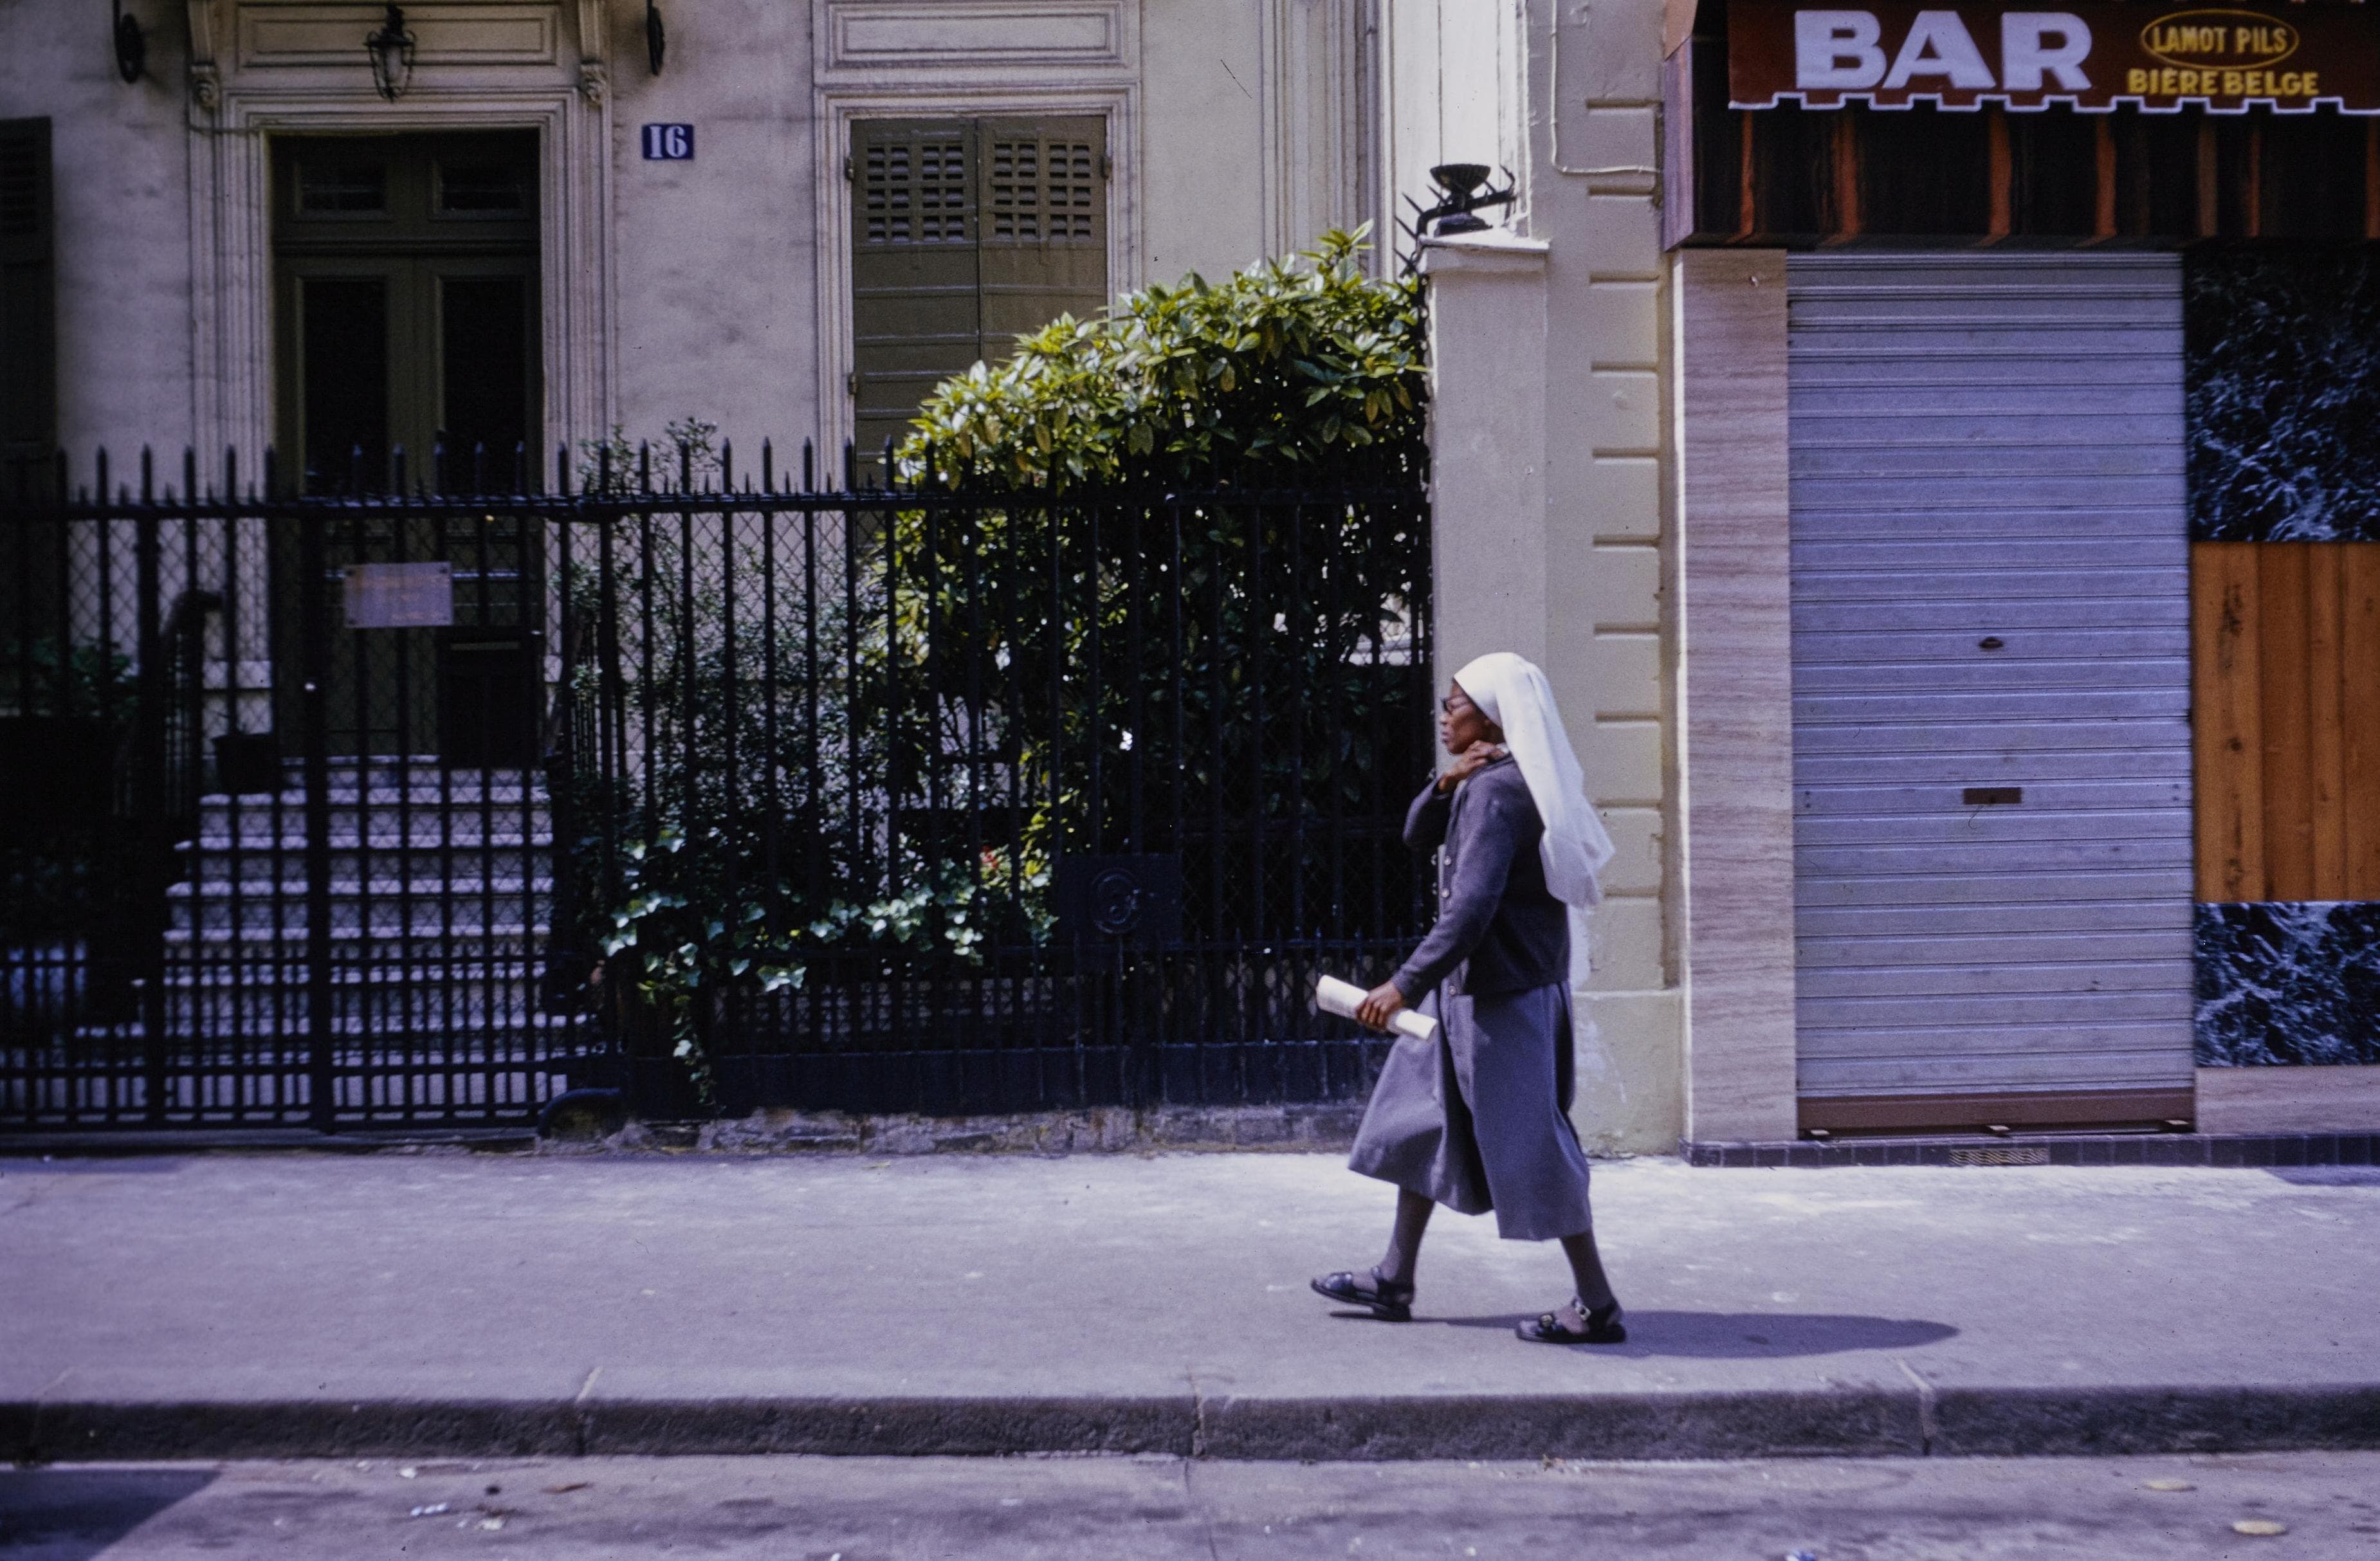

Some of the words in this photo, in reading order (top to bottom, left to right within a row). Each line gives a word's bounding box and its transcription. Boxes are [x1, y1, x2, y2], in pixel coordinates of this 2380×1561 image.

[1794, 10, 2092, 90] BAR
[2153, 26, 2227, 53] LAMOT
[2235, 26, 2288, 53] PILS
[2224, 71, 2320, 96] BELGE
[649, 125, 688, 158] 16
